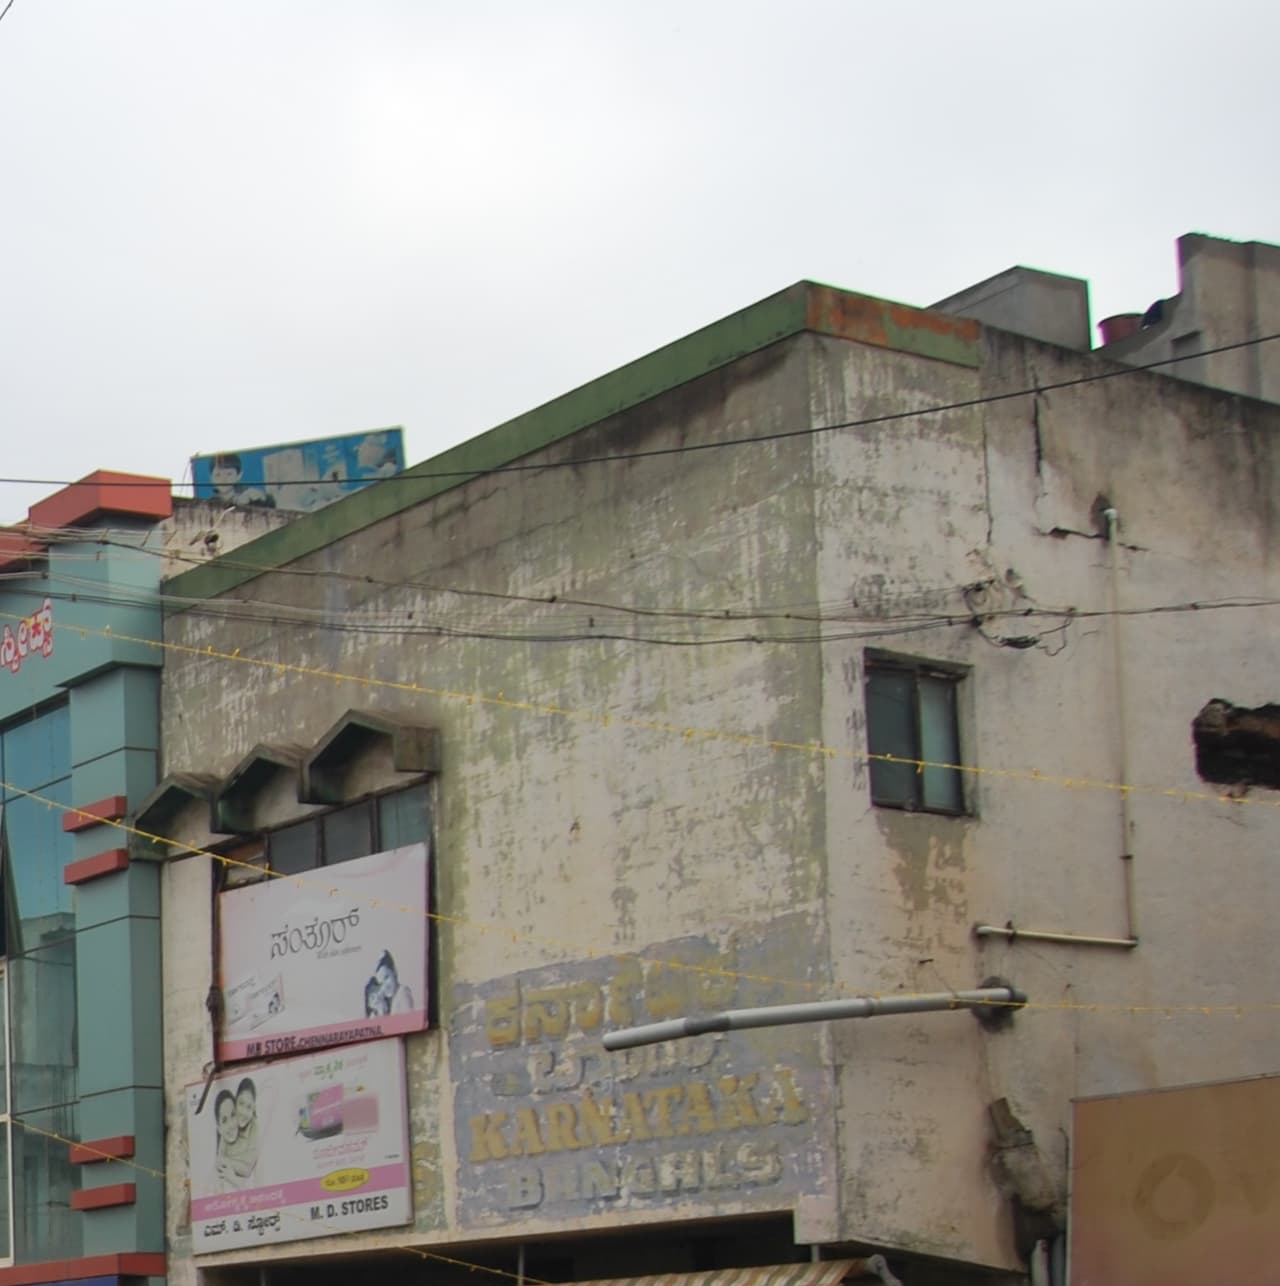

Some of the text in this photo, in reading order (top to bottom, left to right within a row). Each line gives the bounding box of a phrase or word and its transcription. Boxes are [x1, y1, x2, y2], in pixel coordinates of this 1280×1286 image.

[467, 1064, 808, 1163] KARNATAKA
[310, 1195, 389, 1221] M. D. STORES
